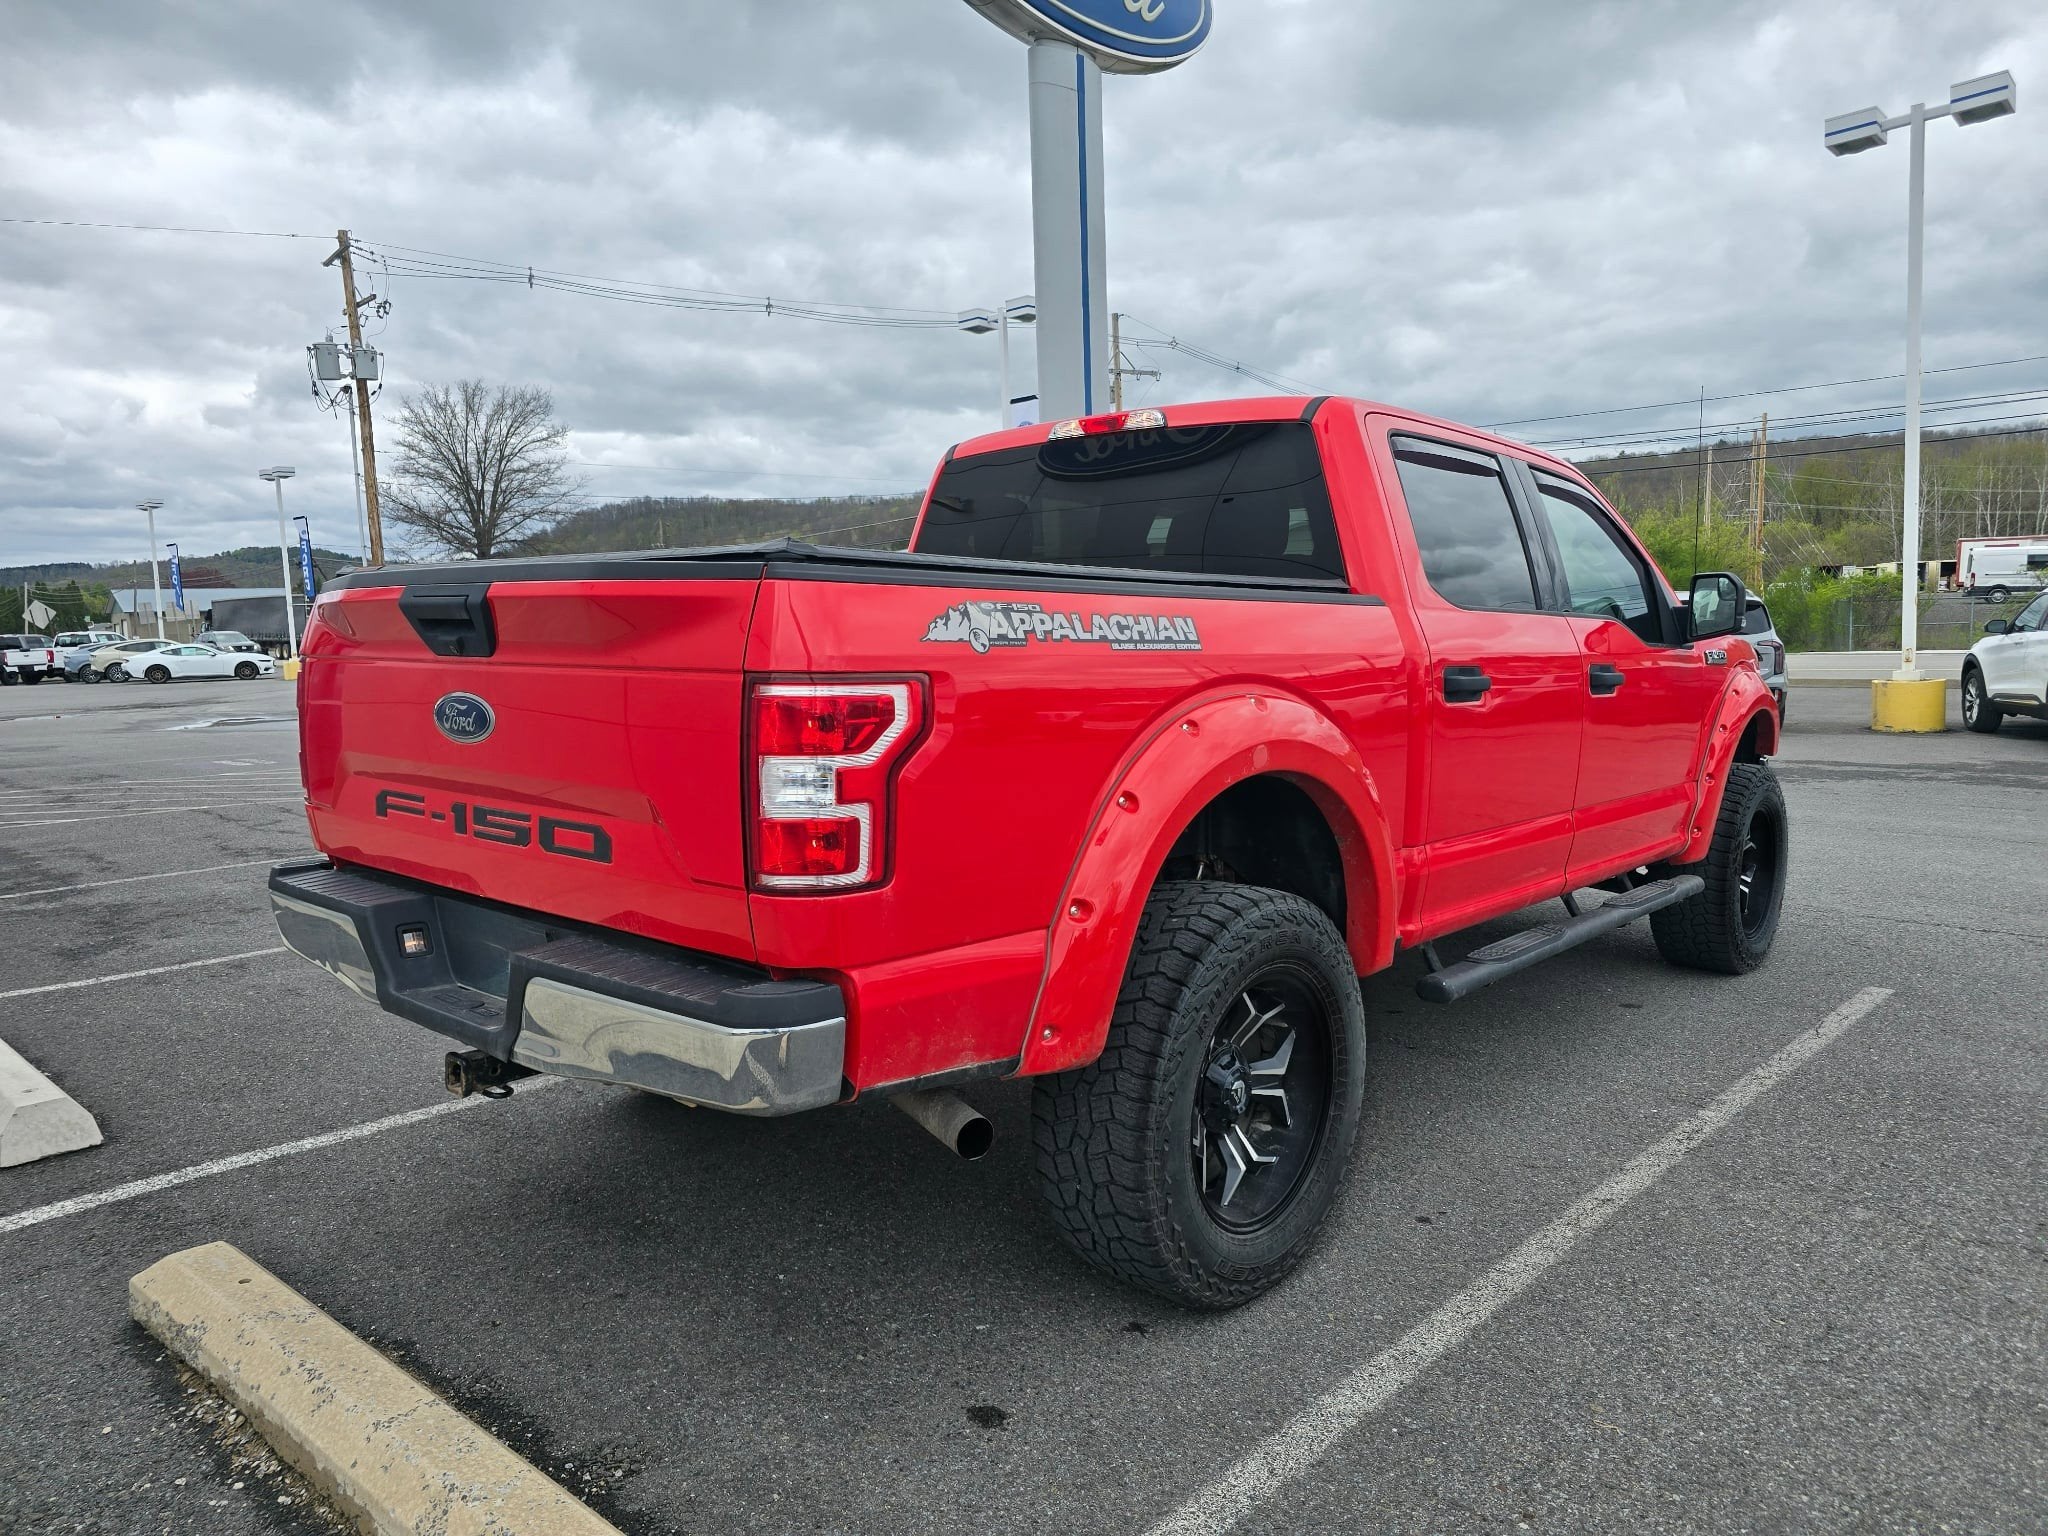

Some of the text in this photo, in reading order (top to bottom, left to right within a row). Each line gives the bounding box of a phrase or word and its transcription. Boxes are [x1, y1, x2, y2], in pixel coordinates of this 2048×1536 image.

[996, 602, 1041, 611] F-150
[989, 611, 1200, 641] APPALACHIAN
[443, 701, 477, 732] Ford
[375, 789, 613, 865] F-150
